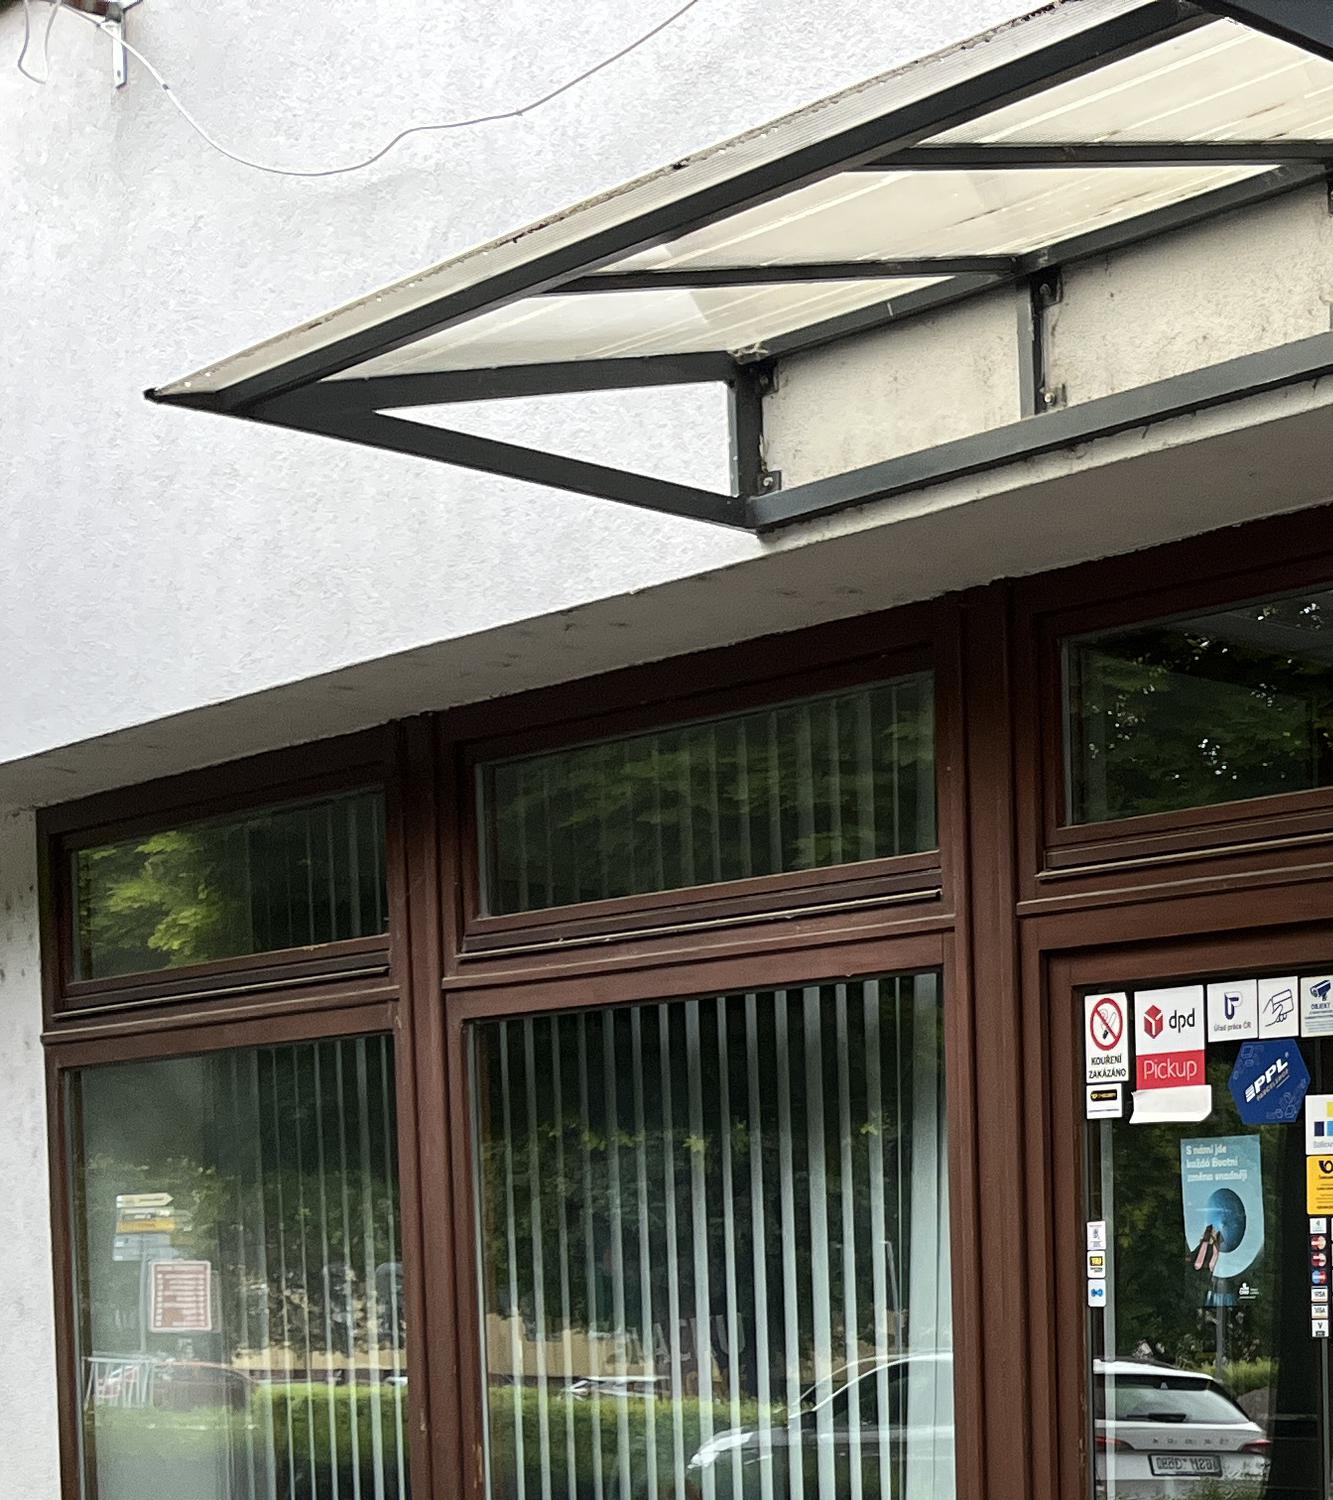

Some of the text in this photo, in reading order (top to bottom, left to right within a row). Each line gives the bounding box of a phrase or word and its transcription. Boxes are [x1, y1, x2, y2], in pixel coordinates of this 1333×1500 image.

[1169, 1008, 1195, 1033] dpd
[1144, 1058, 1197, 1080] Pickup
[1254, 1058, 1289, 1094] PPL
